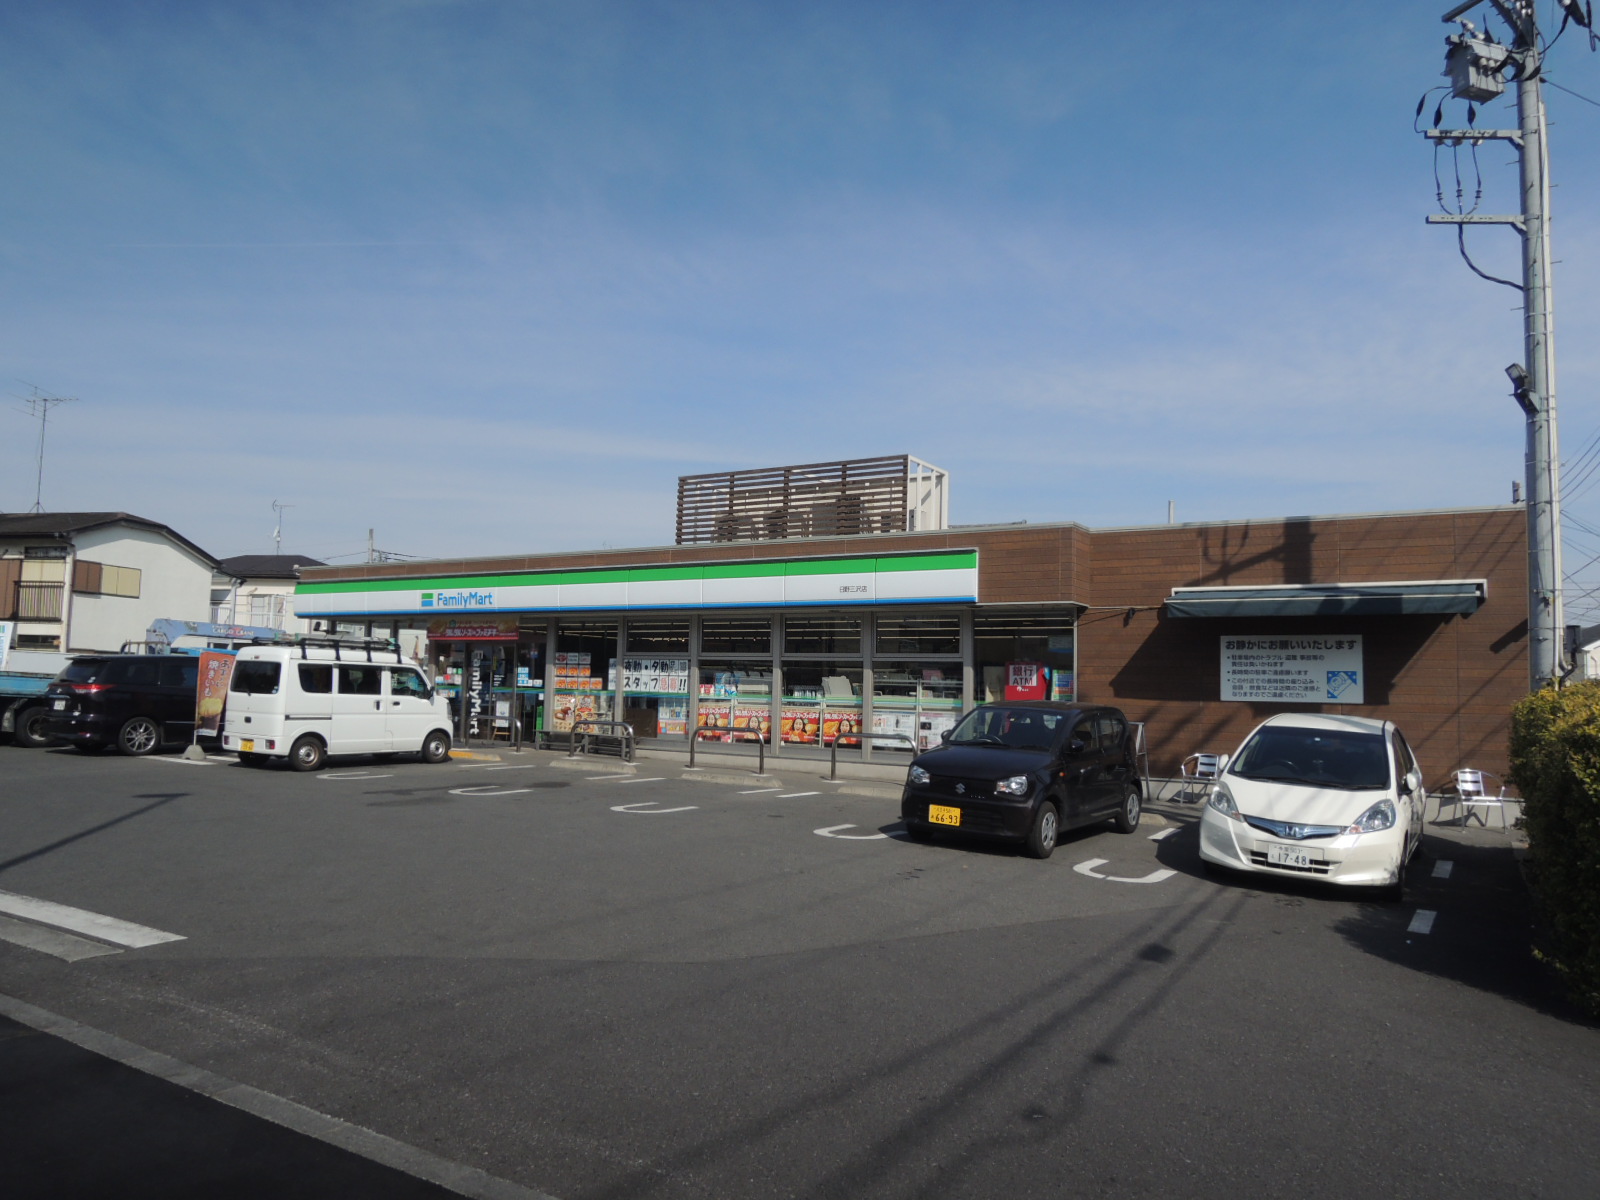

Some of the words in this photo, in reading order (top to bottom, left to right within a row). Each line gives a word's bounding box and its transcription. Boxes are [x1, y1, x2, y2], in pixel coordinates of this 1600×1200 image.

[437, 592, 493, 608] FamilyMart
[1225, 639, 1357, 650] お静かにお願いいたします
[1012, 665, 1034, 677] 銀行
[1012, 677, 1033, 686] ATM
[935, 813, 958, 824] 66-93
[1278, 852, 1307, 866] 17-48
